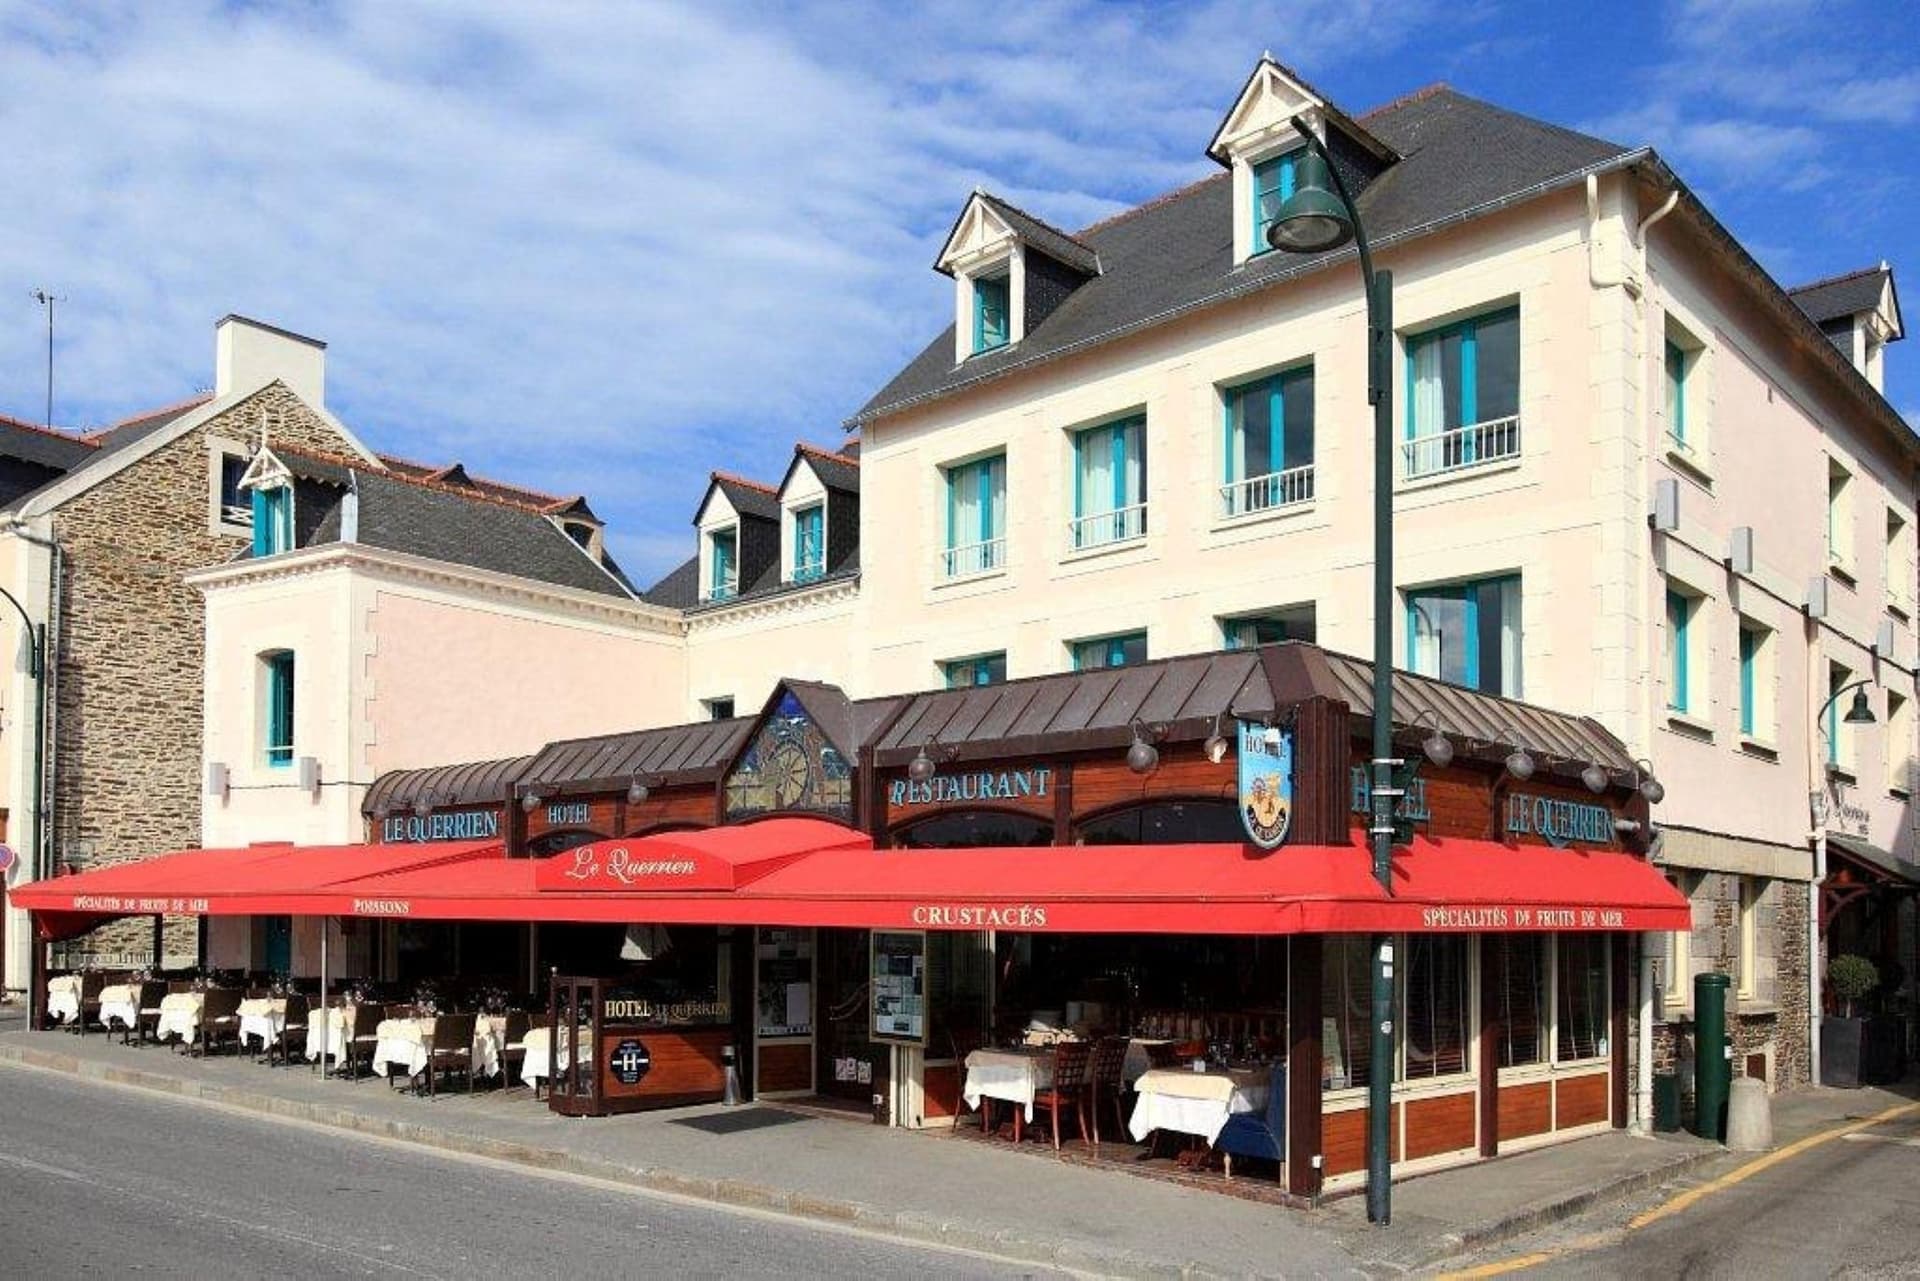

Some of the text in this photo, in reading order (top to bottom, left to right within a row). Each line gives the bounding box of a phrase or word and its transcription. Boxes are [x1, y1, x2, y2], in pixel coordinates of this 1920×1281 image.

[889, 769, 1051, 806] RESTAURANT
[547, 803, 591, 824] HOTEL
[1507, 793, 1616, 848] LE QUERRIEN
[384, 811, 499, 843] LE QUERRIEN
[564, 847, 696, 884] Le Querrien
[353, 899, 409, 914] POISSONS
[913, 904, 1047, 927] CRUSTACÉS
[1423, 906, 1624, 927] SPÉCIALITÉS DE FRUITS DE MER
[604, 1000, 651, 1018] HOTEL
[623, 1053, 637, 1071] H
